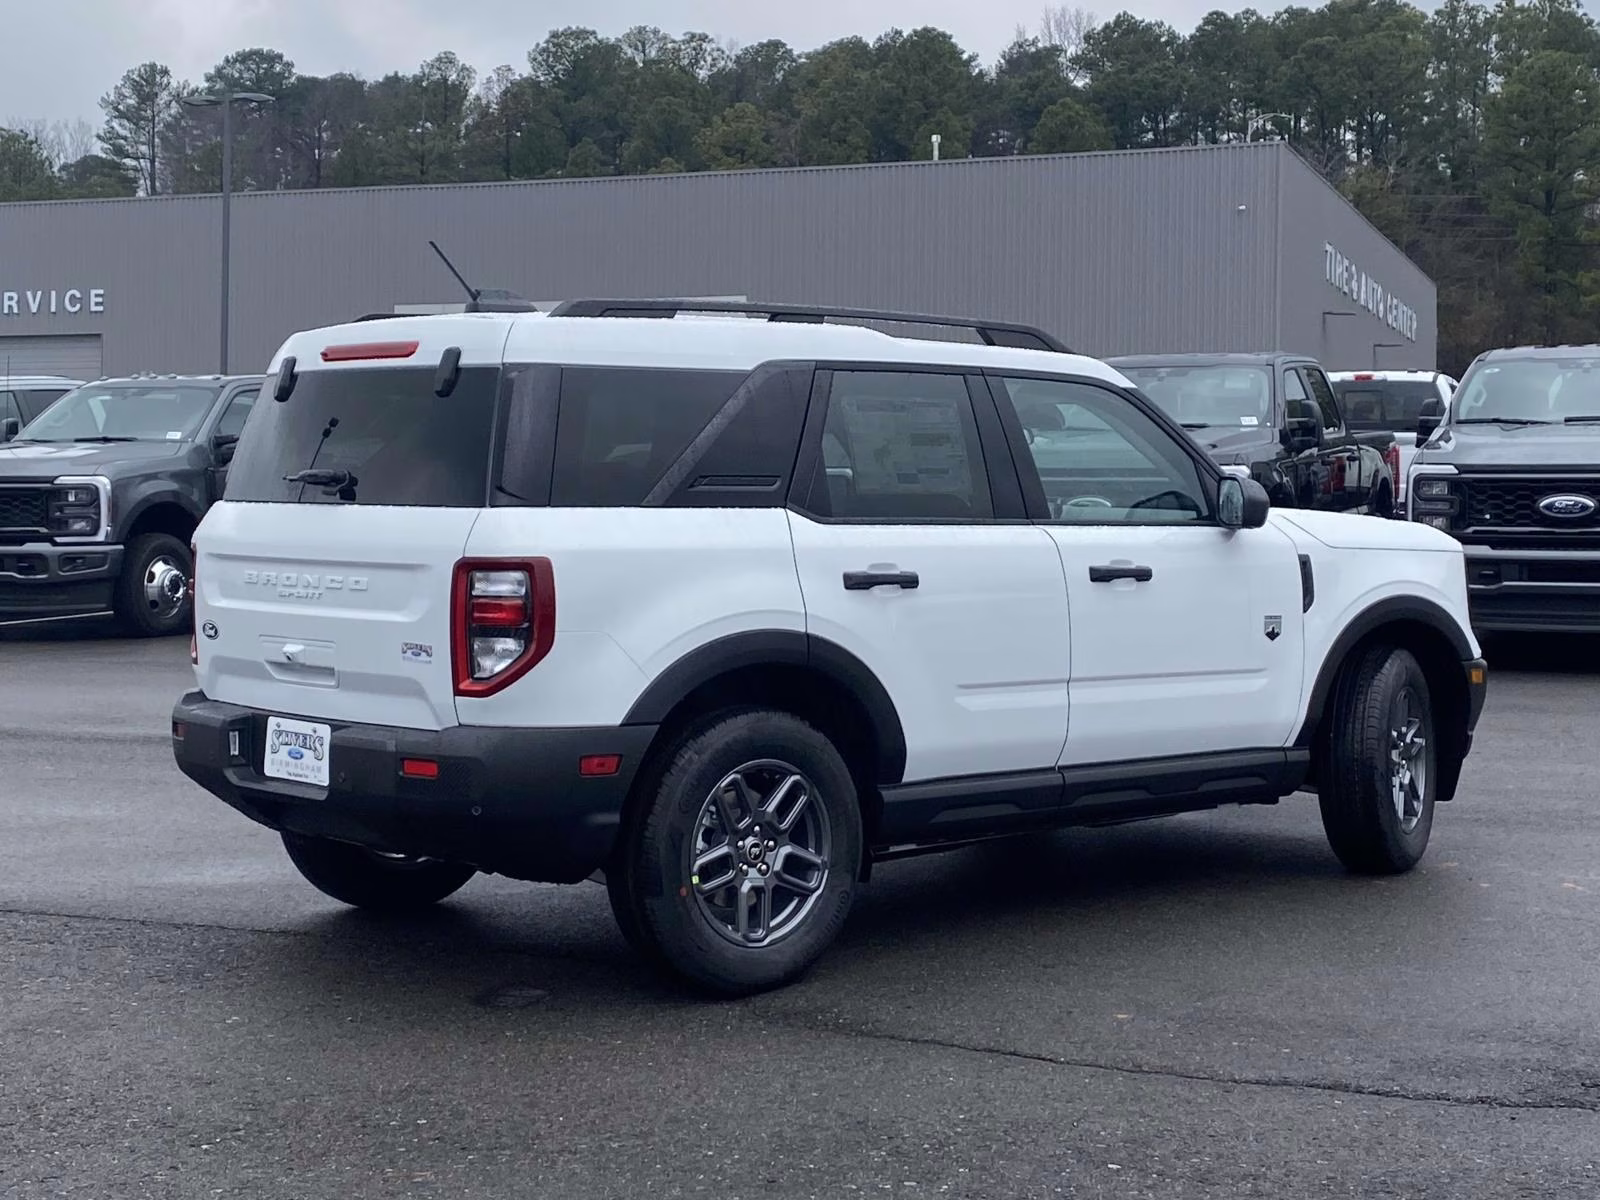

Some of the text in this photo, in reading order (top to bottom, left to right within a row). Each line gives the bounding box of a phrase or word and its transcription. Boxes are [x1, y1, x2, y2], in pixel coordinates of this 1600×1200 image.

[2, 288, 105, 315] RVICE
[1325, 241, 1350, 294] TIRE
[1360, 271, 1384, 320] AUTO
[1386, 292, 1417, 343] CENTER
[244, 570, 368, 591] BRONCO
